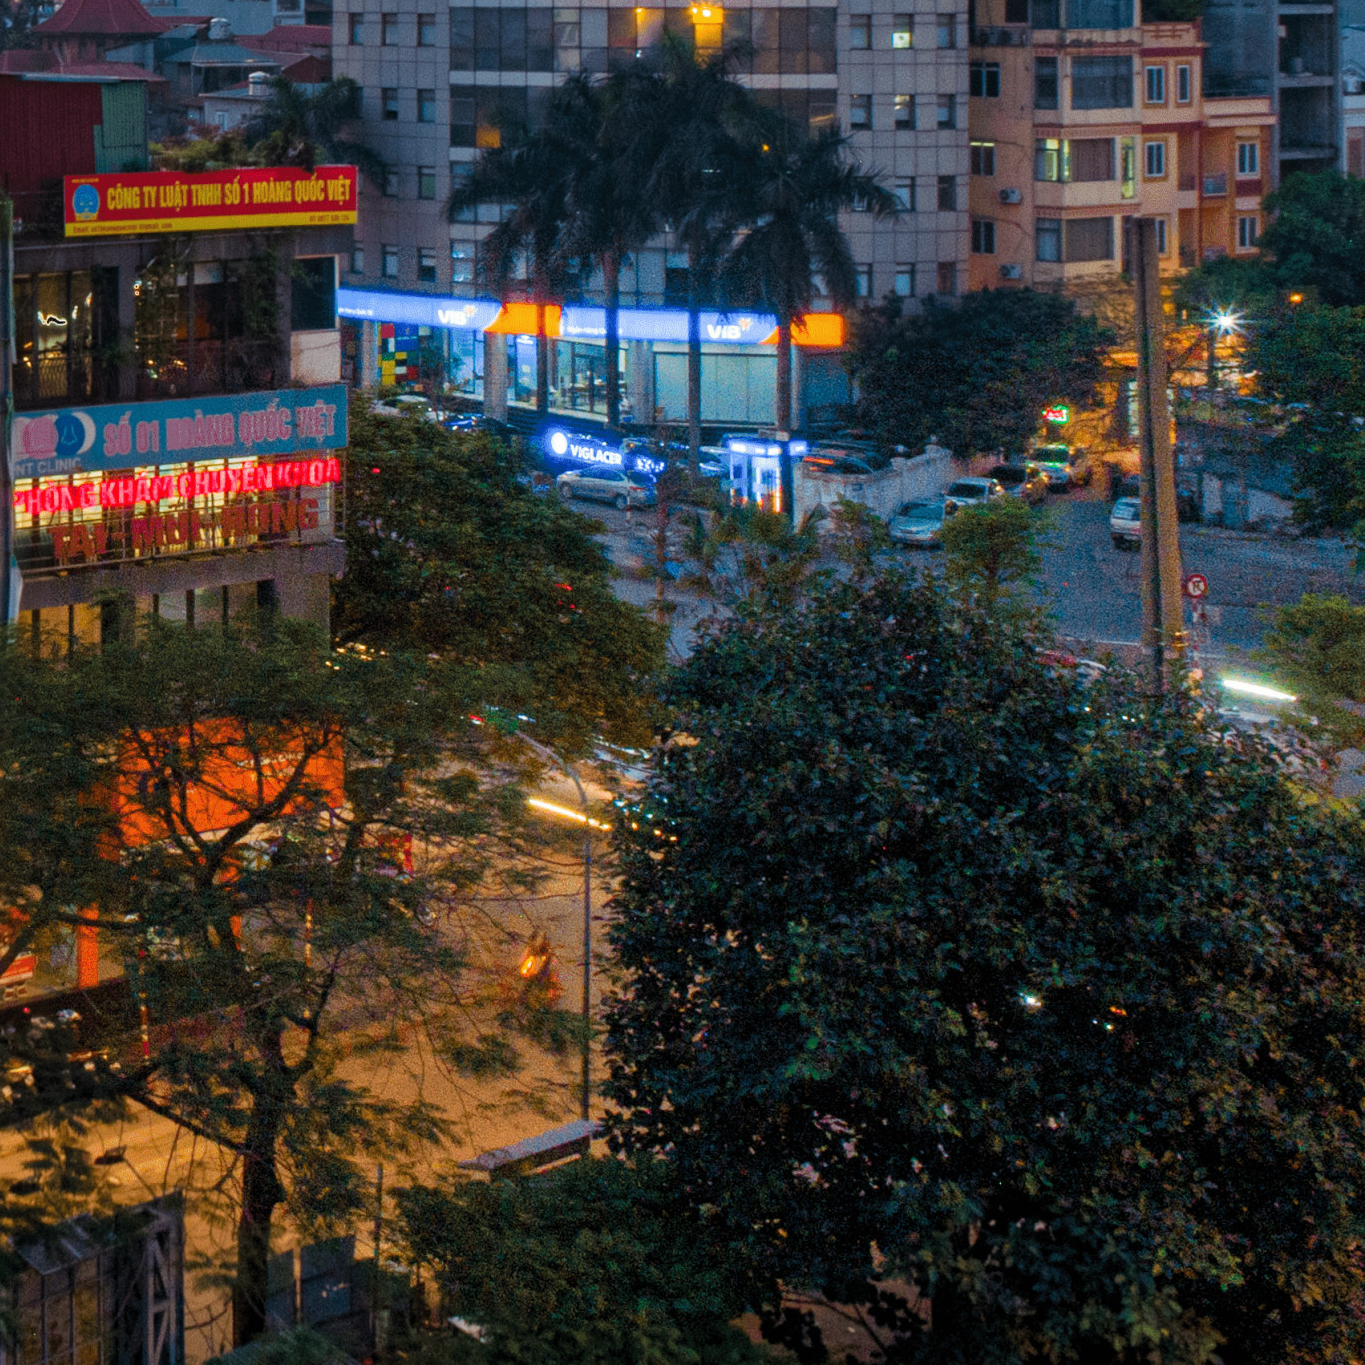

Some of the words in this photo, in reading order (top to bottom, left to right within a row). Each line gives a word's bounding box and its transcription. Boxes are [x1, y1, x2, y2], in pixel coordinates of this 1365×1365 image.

[107, 183, 140, 210] CÔNG
[142, 186, 157, 208] TY
[159, 180, 189, 212] LUẬT
[191, 183, 222, 206] TNHH
[224, 175, 241, 205] SỐ
[243, 183, 250, 204] 1
[252, 177, 293, 204] HOÀNG
[295, 173, 325, 205] QUỐC
[327, 174, 352, 206] VIỆT
[438, 309, 468, 326] VIB
[707, 324, 742, 339] VIB
[103, 410, 132, 457] SỐ
[136, 420, 160, 453] 01
[166, 409, 236, 451] HOÀNG
[238, 398, 293, 447] QUỐC
[295, 399, 337, 444] VIỆT
[570, 444, 623, 465] VIGLACER
[14, 461, 35, 476] NT
[37, 457, 81, 475] CLINIC
[14, 479, 97, 515] PHÒNG
[100, 471, 174, 508] KHÁM
[177, 460, 274, 500] CHUYÊN
[275, 457, 341, 490] KHOA
